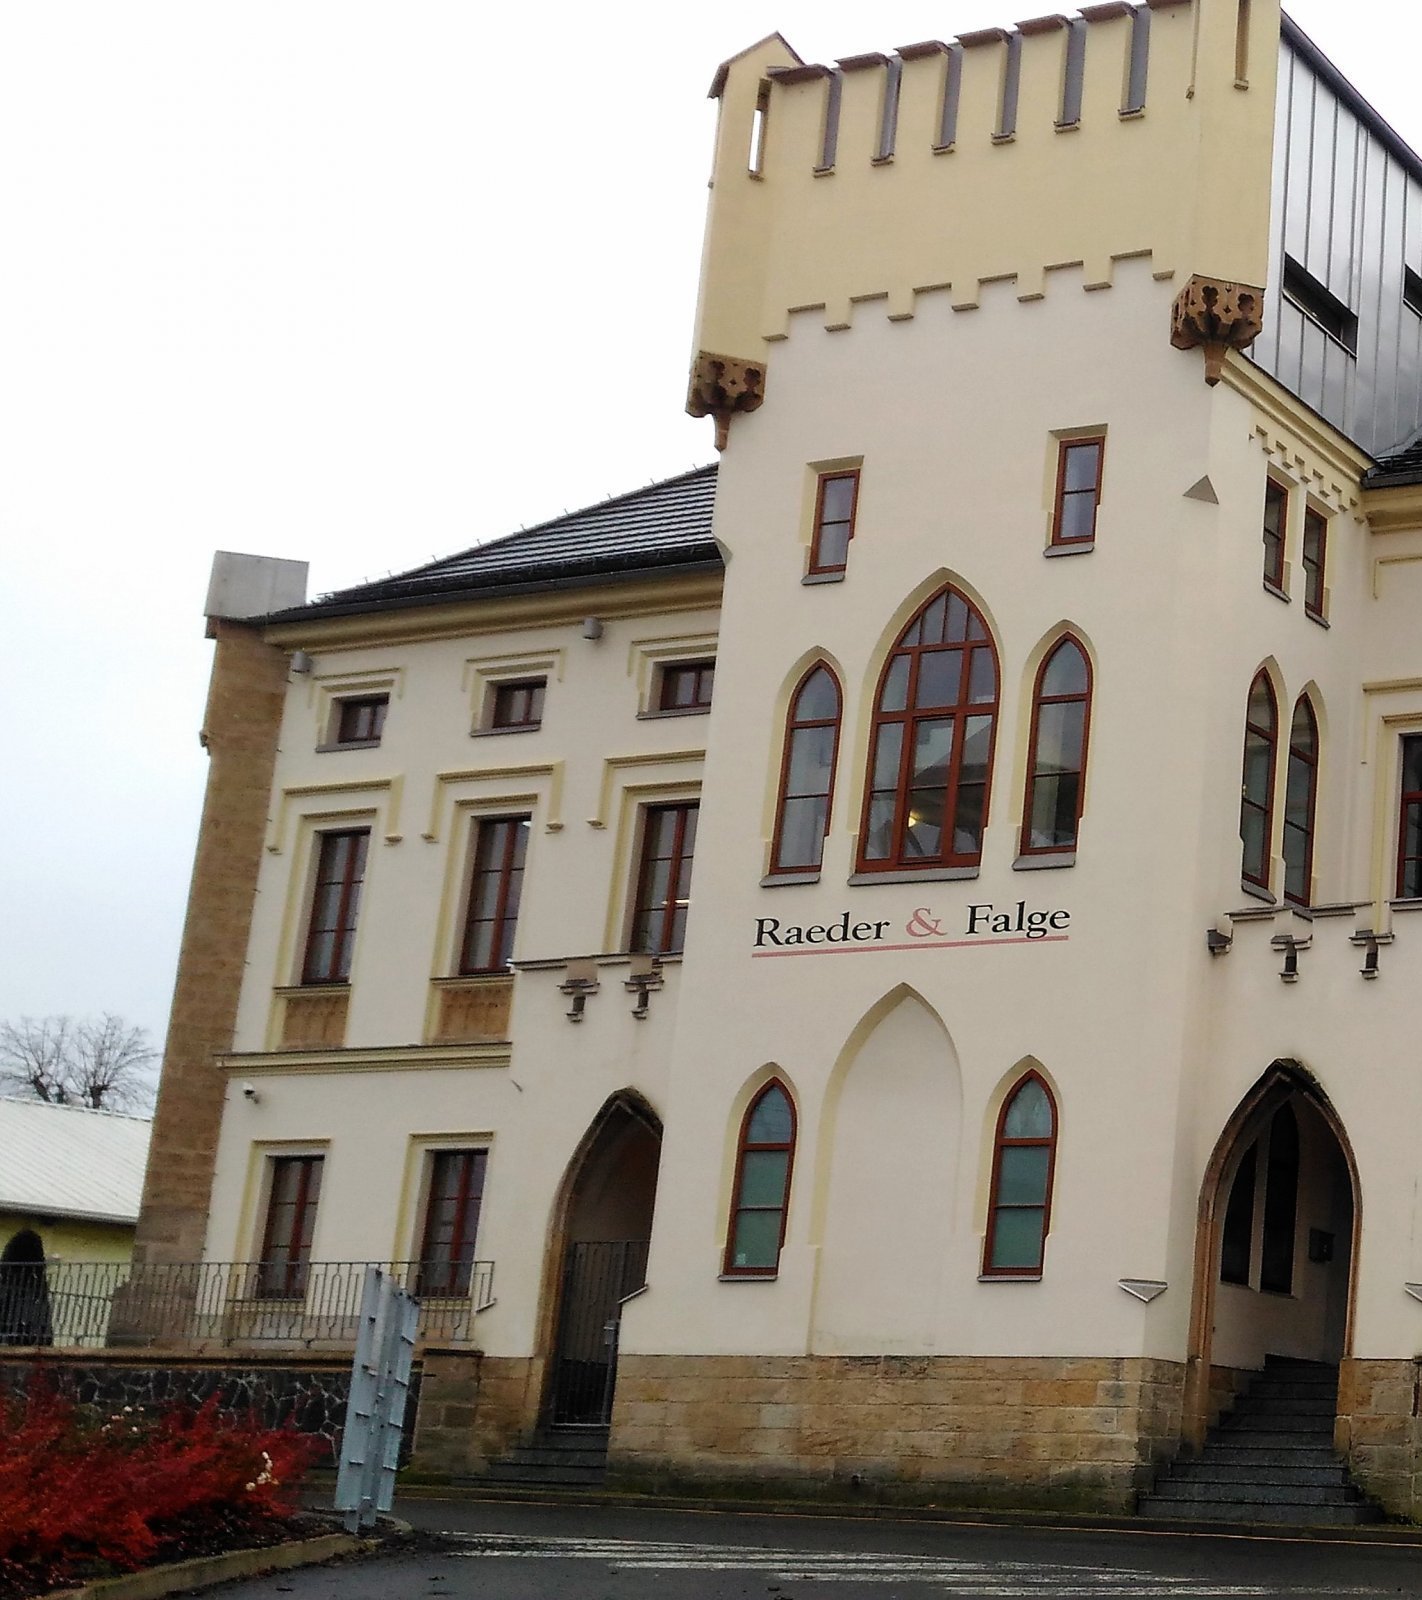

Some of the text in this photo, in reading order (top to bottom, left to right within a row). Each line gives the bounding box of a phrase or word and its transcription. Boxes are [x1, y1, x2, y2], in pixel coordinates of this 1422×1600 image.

[753, 900, 1072, 947] Raeder & Falge
